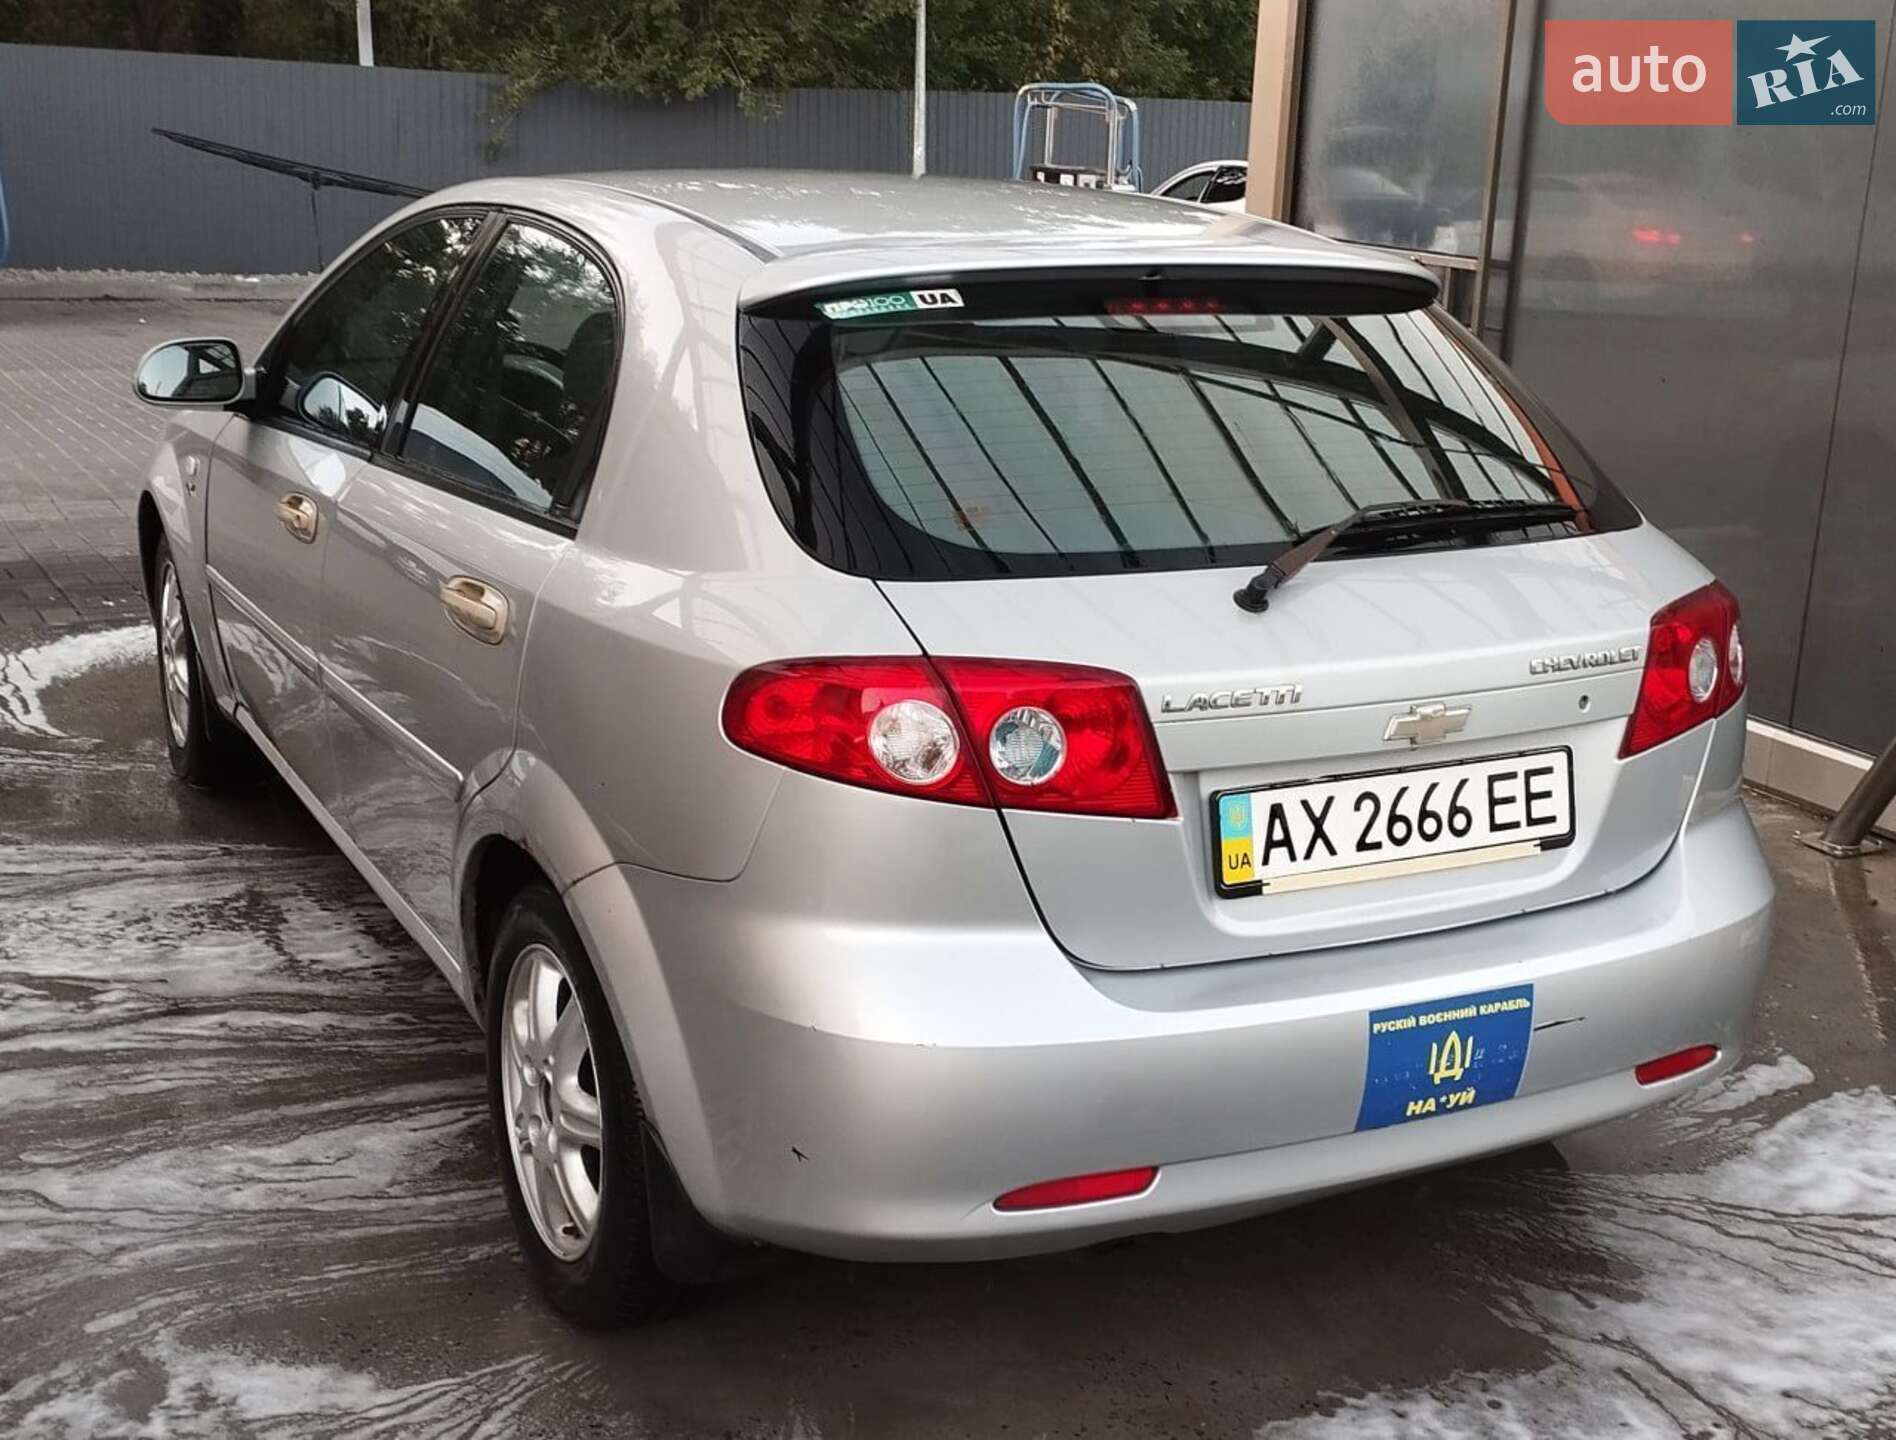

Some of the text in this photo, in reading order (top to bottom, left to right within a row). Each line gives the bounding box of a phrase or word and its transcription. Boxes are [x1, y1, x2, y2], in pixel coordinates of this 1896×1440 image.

[917, 293, 959, 306] UA
[1529, 646, 1641, 675] CHEVROLET
[1161, 684, 1303, 713] LACETTI
[1262, 766, 1557, 866] AX 2666 EE
[1228, 852, 1251, 870] UA
[1479, 998, 1531, 1016] КАРАБЛЬ
[1406, 1097, 1437, 1116] НА
